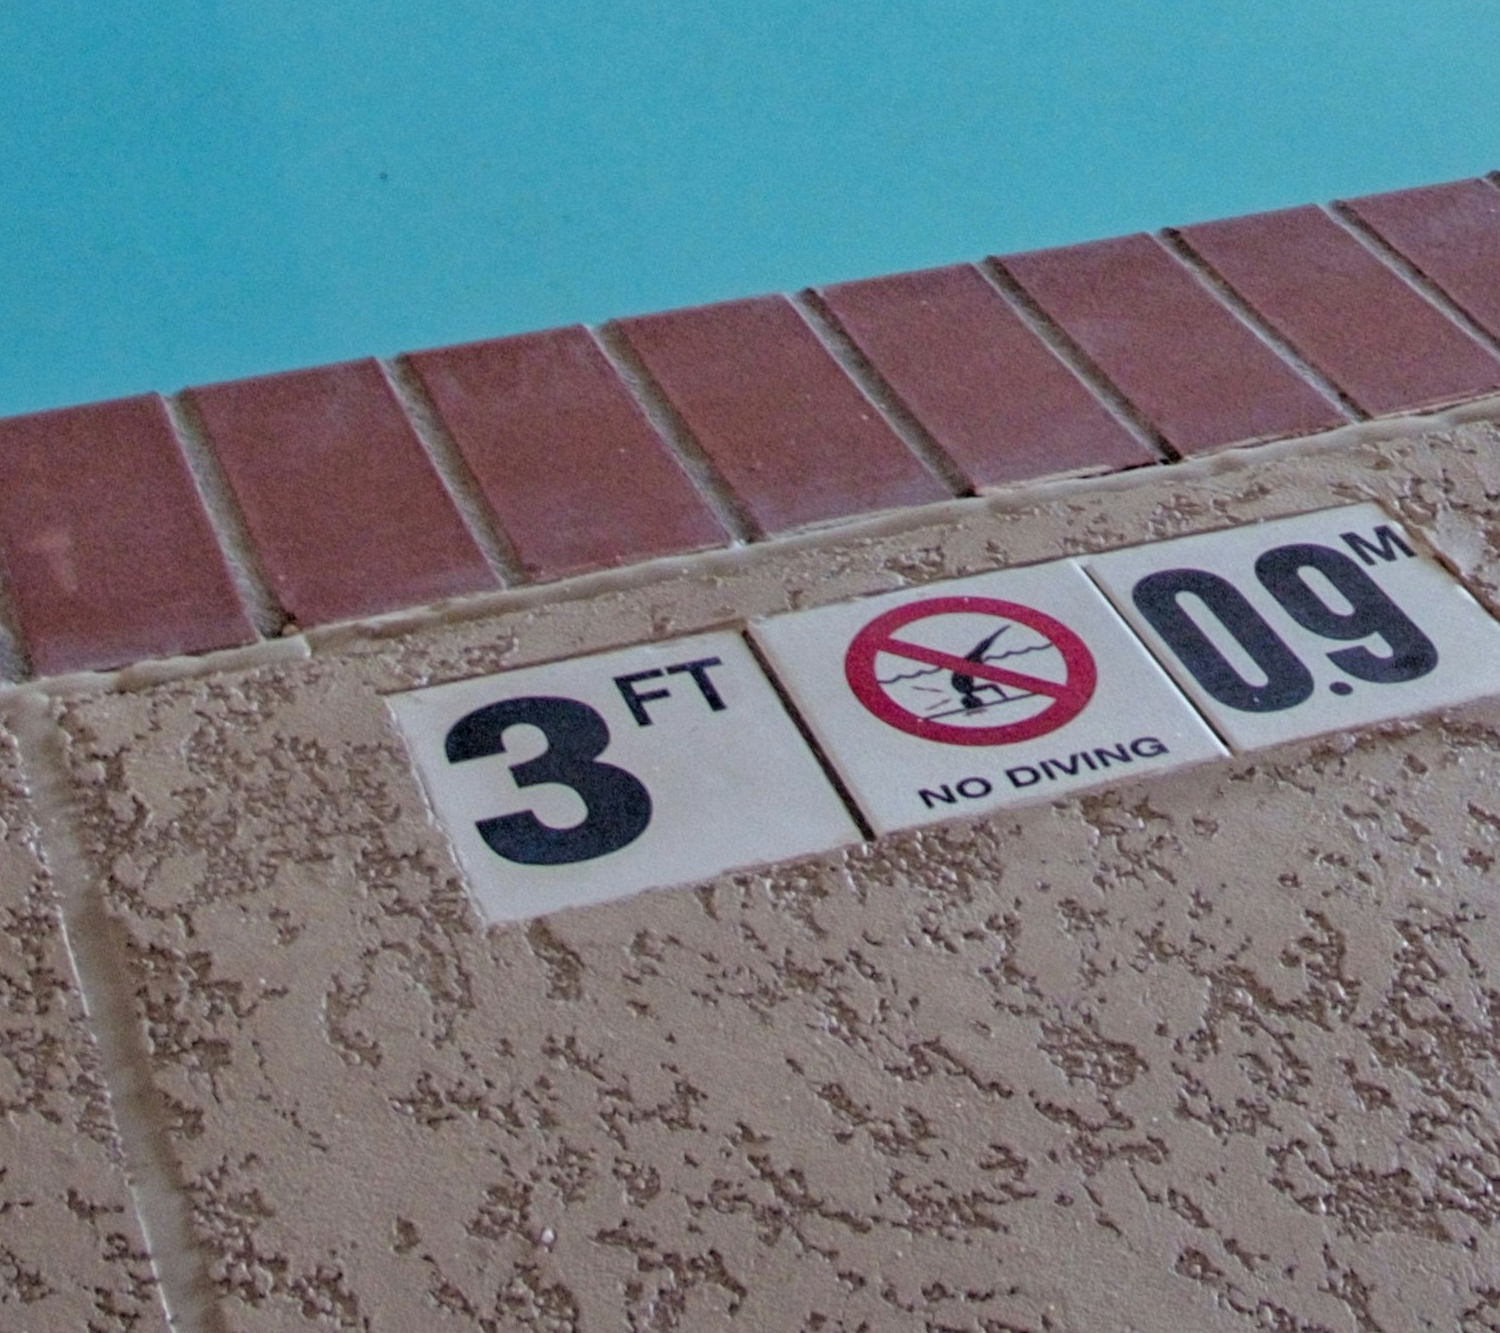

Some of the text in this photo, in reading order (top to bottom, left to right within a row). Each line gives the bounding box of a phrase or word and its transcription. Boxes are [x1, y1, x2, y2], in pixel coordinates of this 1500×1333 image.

[1132, 523, 1440, 714] 0.9 M
[444, 655, 729, 867] 3 FT
[917, 736, 1170, 810] NO DIVING
